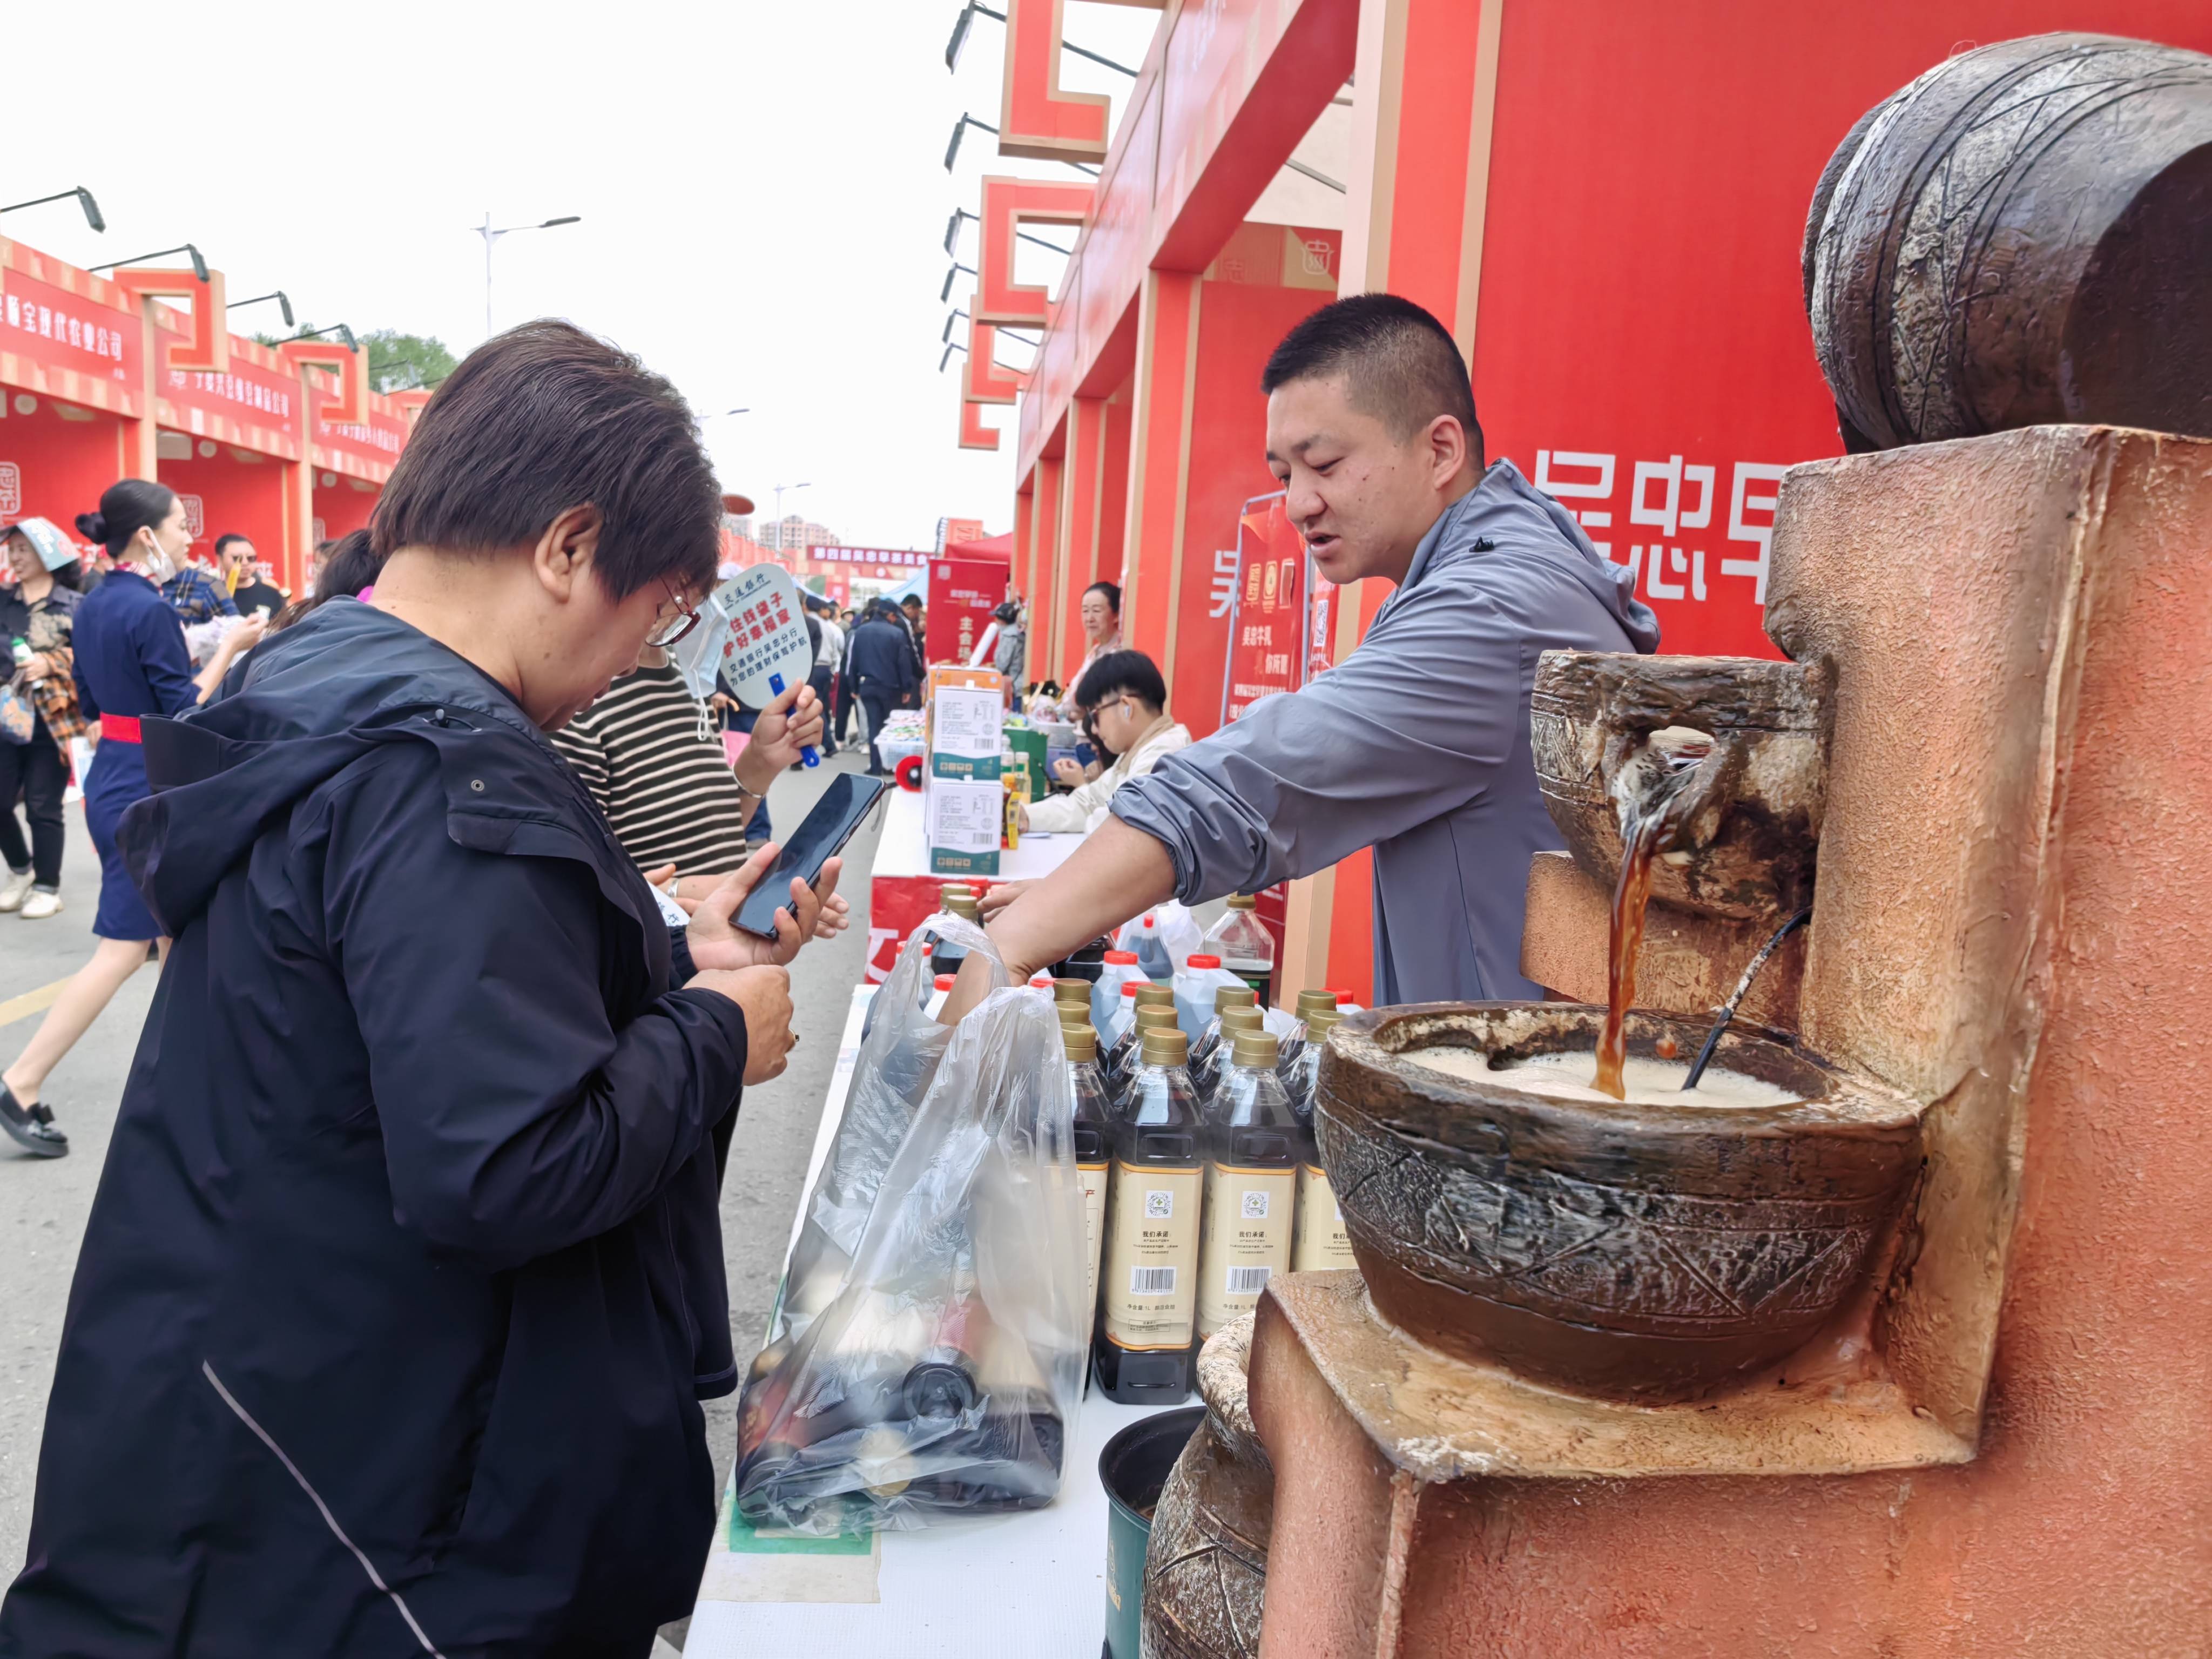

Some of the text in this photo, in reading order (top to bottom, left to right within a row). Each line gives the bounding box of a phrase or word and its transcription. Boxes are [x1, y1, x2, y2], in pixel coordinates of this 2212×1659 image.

[725, 573, 765, 605] 交通银行
[725, 591, 783, 639] 住钱袋子
[730, 628, 798, 673] 交通银行吴忠分行
[730, 637, 807, 687] 为您的理财保驾护航
